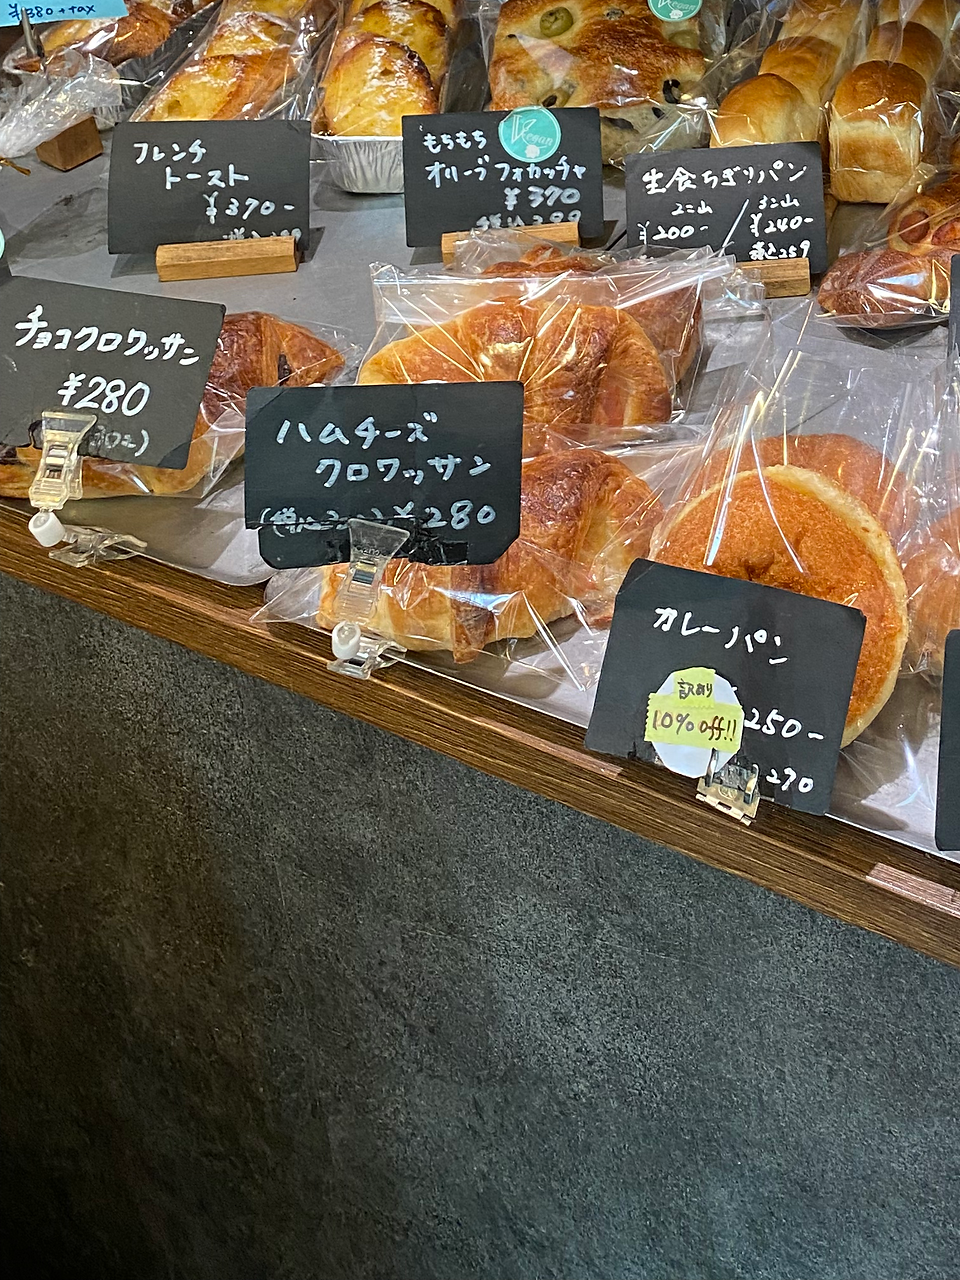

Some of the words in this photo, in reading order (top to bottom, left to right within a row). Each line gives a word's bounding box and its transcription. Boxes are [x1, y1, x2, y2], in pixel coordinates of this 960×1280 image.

[422, 129, 488, 155] もちもち
[510, 114, 554, 147] Vegan
[133, 138, 207, 165] フレンチ
[165, 163, 250, 190] トースト
[641, 159, 808, 195] 生食ちぎりパン
[503, 184, 581, 211] ¥370
[14, 303, 200, 367] チョコクロワッサン
[57, 372, 151, 418] ¥280
[275, 410, 439, 450] ハムチーズ
[314, 452, 492, 488] クロワッサン
[652, 606, 789, 665] カレーパン
[651, 709, 695, 733] 10%
[764, 766, 815, 794] 270
